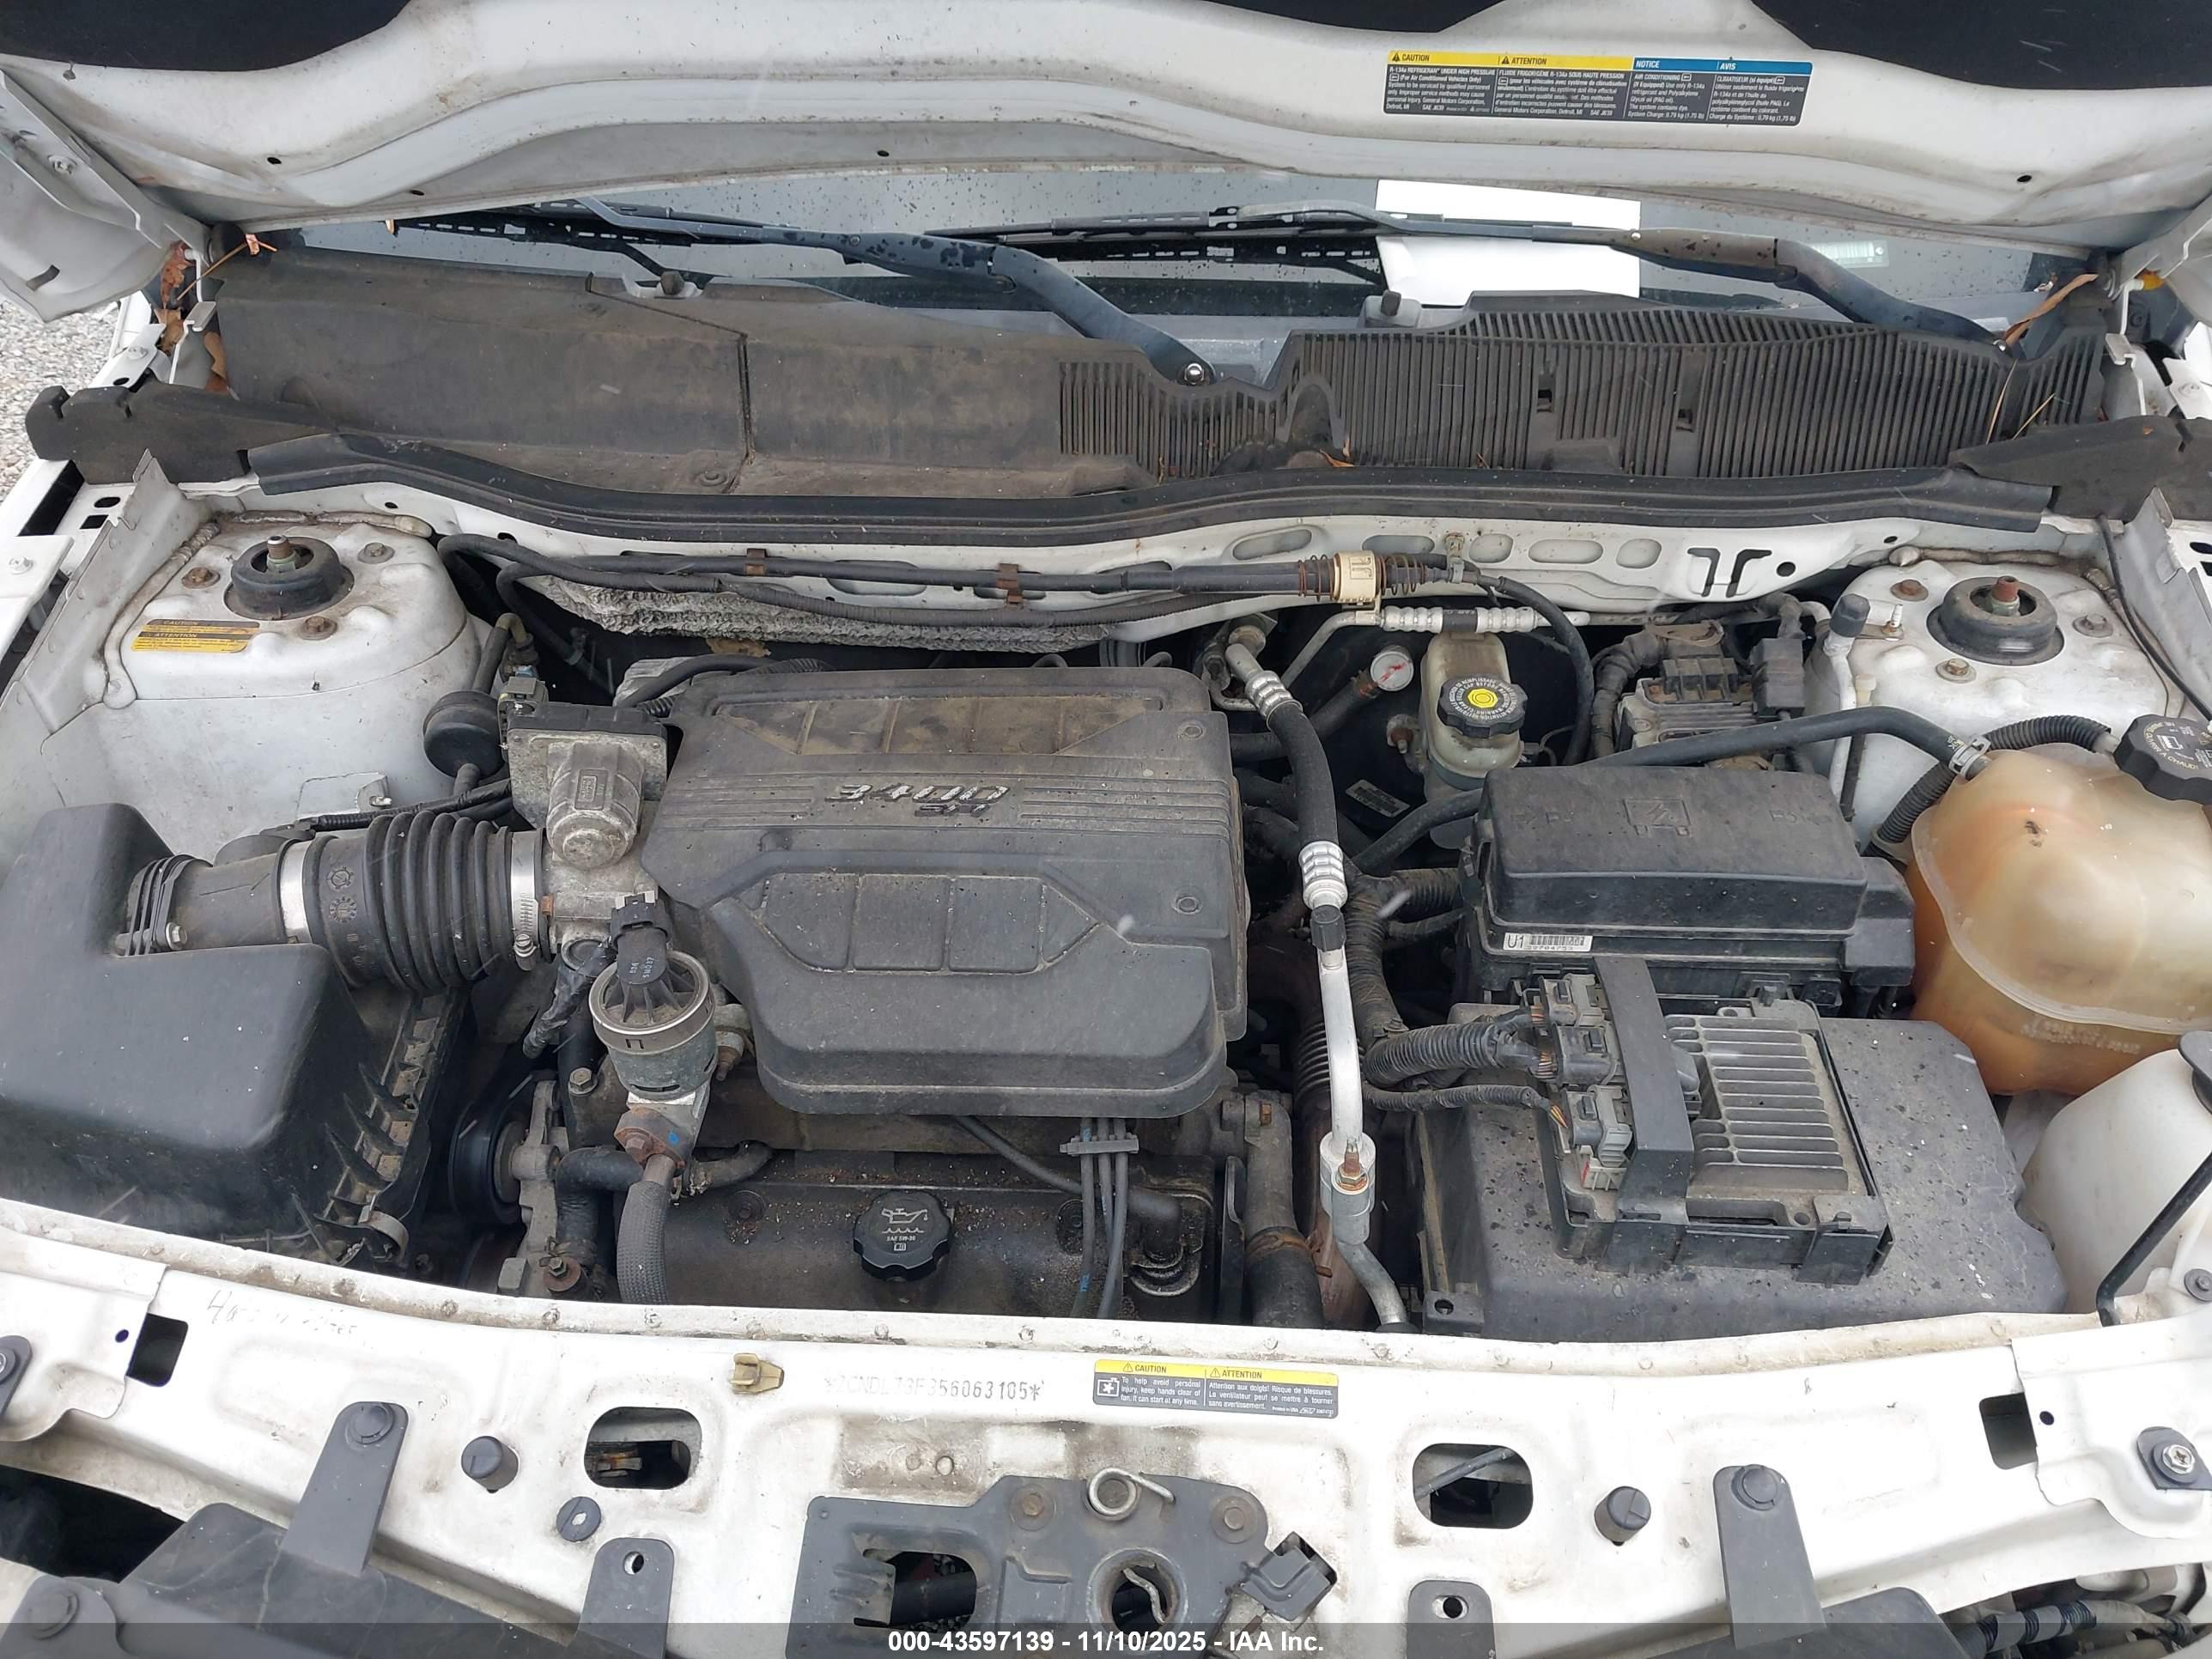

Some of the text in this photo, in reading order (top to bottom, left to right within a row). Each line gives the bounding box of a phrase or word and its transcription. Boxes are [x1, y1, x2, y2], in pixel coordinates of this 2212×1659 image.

[824, 784, 1010, 804] 3400
[1508, 934, 1524, 949] U1
[1222, 1369, 1261, 1378] ATTENTION
[1175, 1379, 1200, 1388] personal
[1209, 1382, 1235, 1390] Attention
[1219, 1391, 1250, 1400] ventilateur
[1281, 1395, 1301, 1403] mettre
[1311, 1396, 1333, 1405] tourner
[1224, 1401, 1266, 1409] avertissement.
